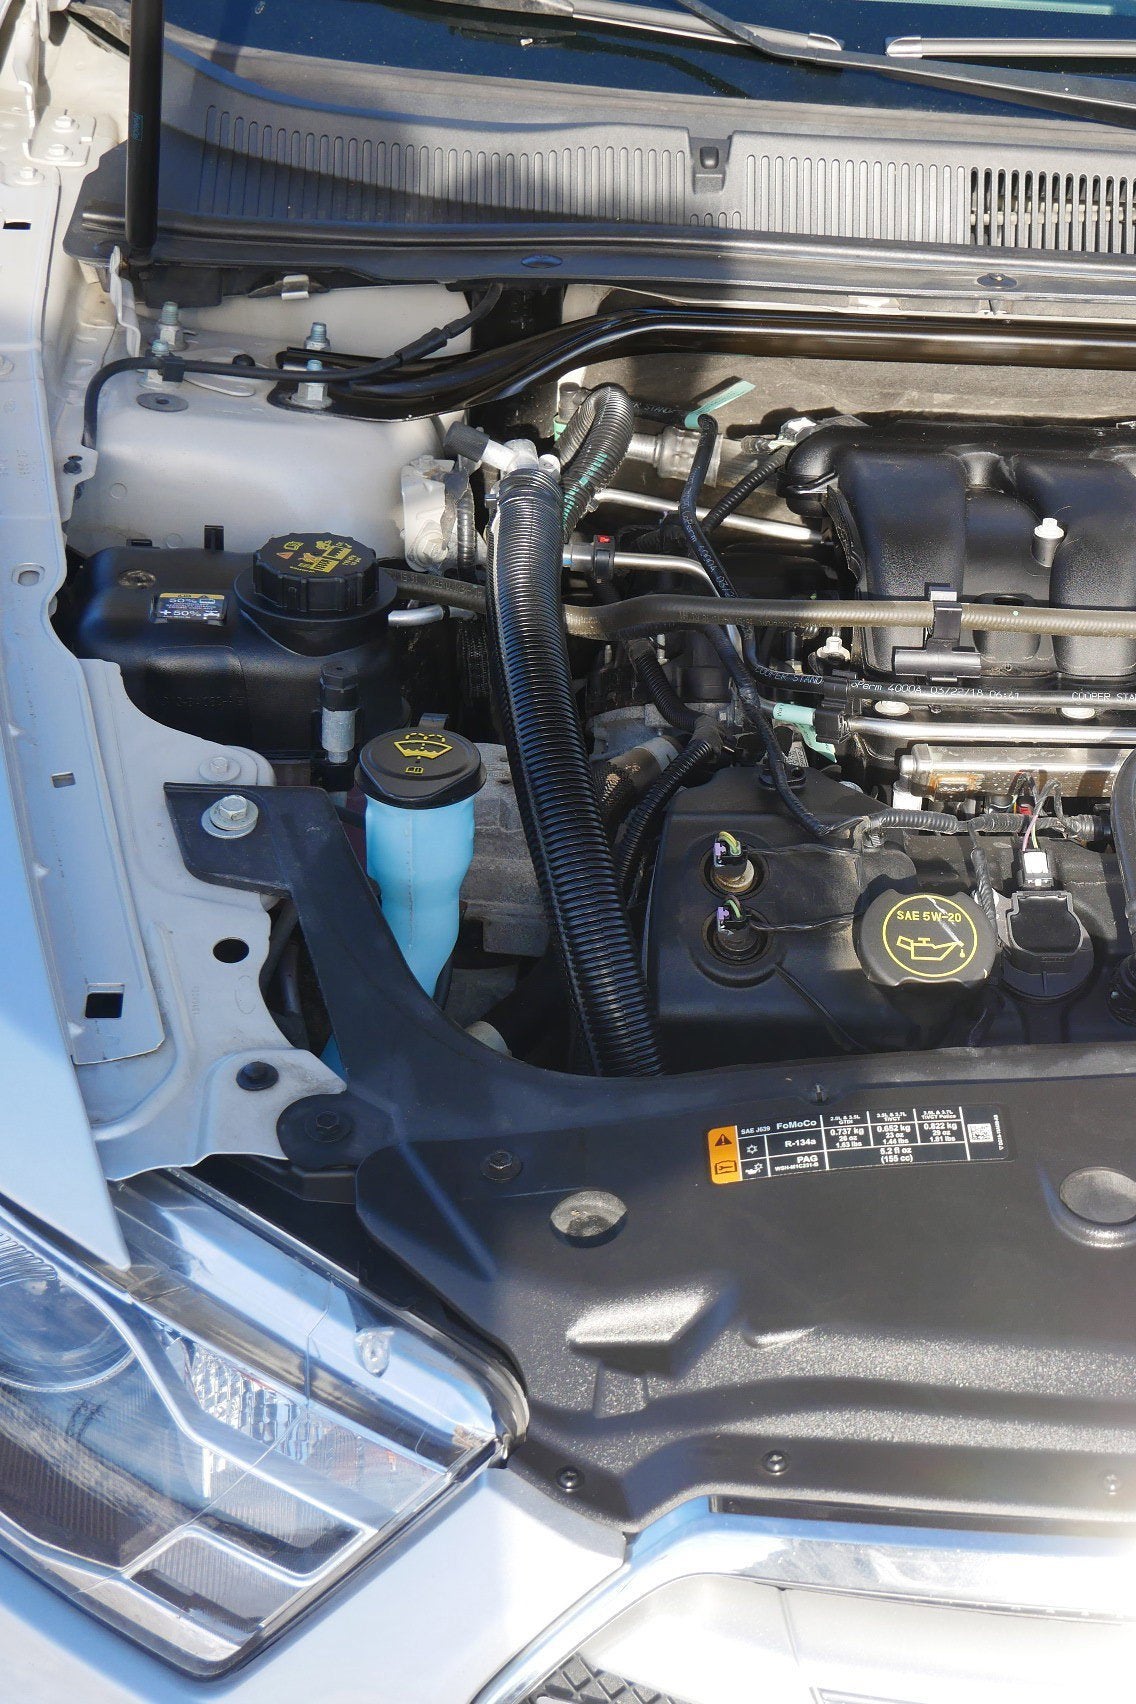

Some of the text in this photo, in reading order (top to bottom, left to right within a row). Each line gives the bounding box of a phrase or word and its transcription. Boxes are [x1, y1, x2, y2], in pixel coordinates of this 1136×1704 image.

[850, 679, 882, 691] oPerm
[887, 684, 922, 694] 4000A
[930, 685, 984, 697] 03/22/18
[989, 690, 1020, 700] 06:41
[1071, 691, 1111, 701] COOPER
[896, 910, 962, 923] SAE 5W-20
[776, 1119, 817, 1130] FoMoCo
[900, 1124, 911, 1133] kg
[946, 1122, 957, 1131] kg
[830, 1127, 865, 1136] 0.737 kg
[784, 1138, 817, 1148] R-134a
[796, 1155, 819, 1164] PAG
[880, 1154, 914, 1165] (155 cc)
